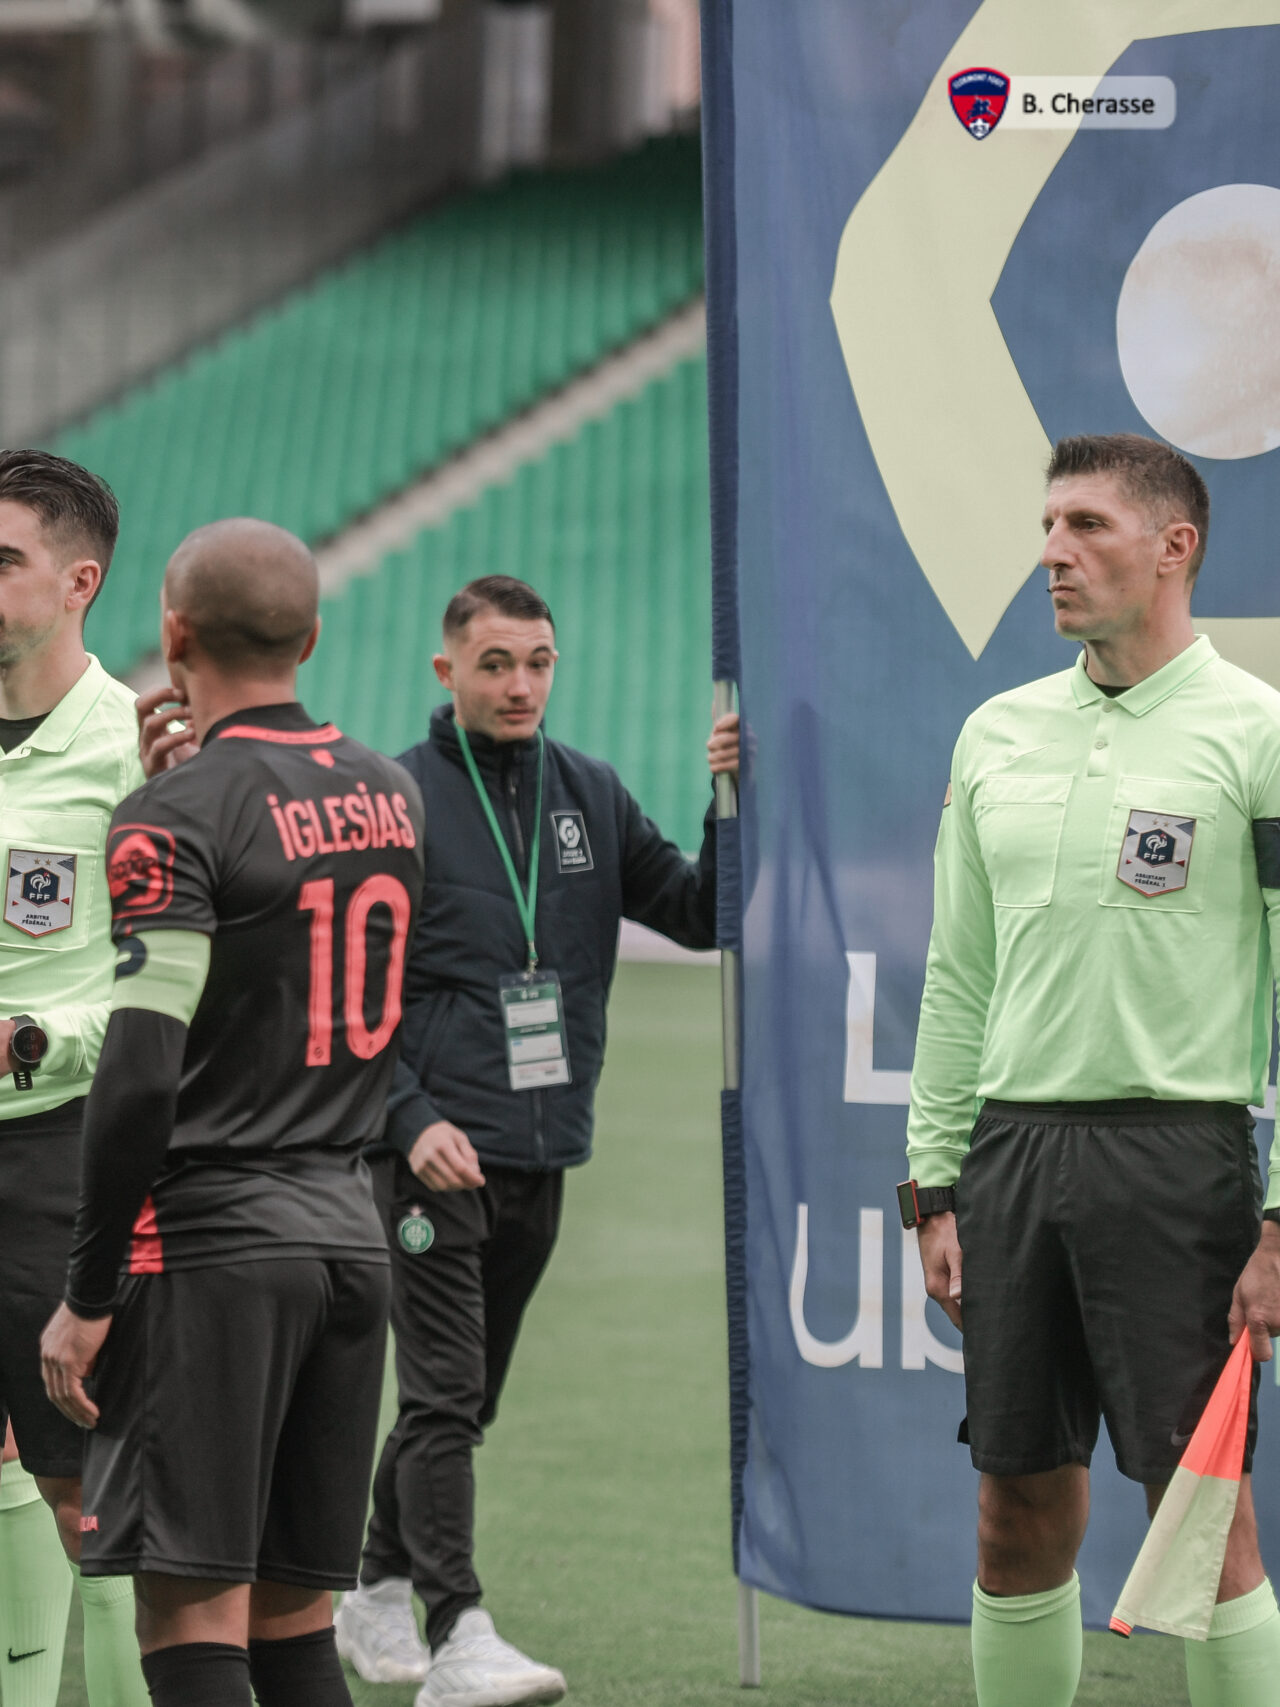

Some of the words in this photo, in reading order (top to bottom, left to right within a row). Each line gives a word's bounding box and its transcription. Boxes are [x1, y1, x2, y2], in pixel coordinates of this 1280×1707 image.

[1144, 853, 1165, 861] FFF
[1134, 872, 1167, 881] ASSISTANT
[25, 913, 50, 921] ARBITRE
[297, 873, 411, 1067] 10
